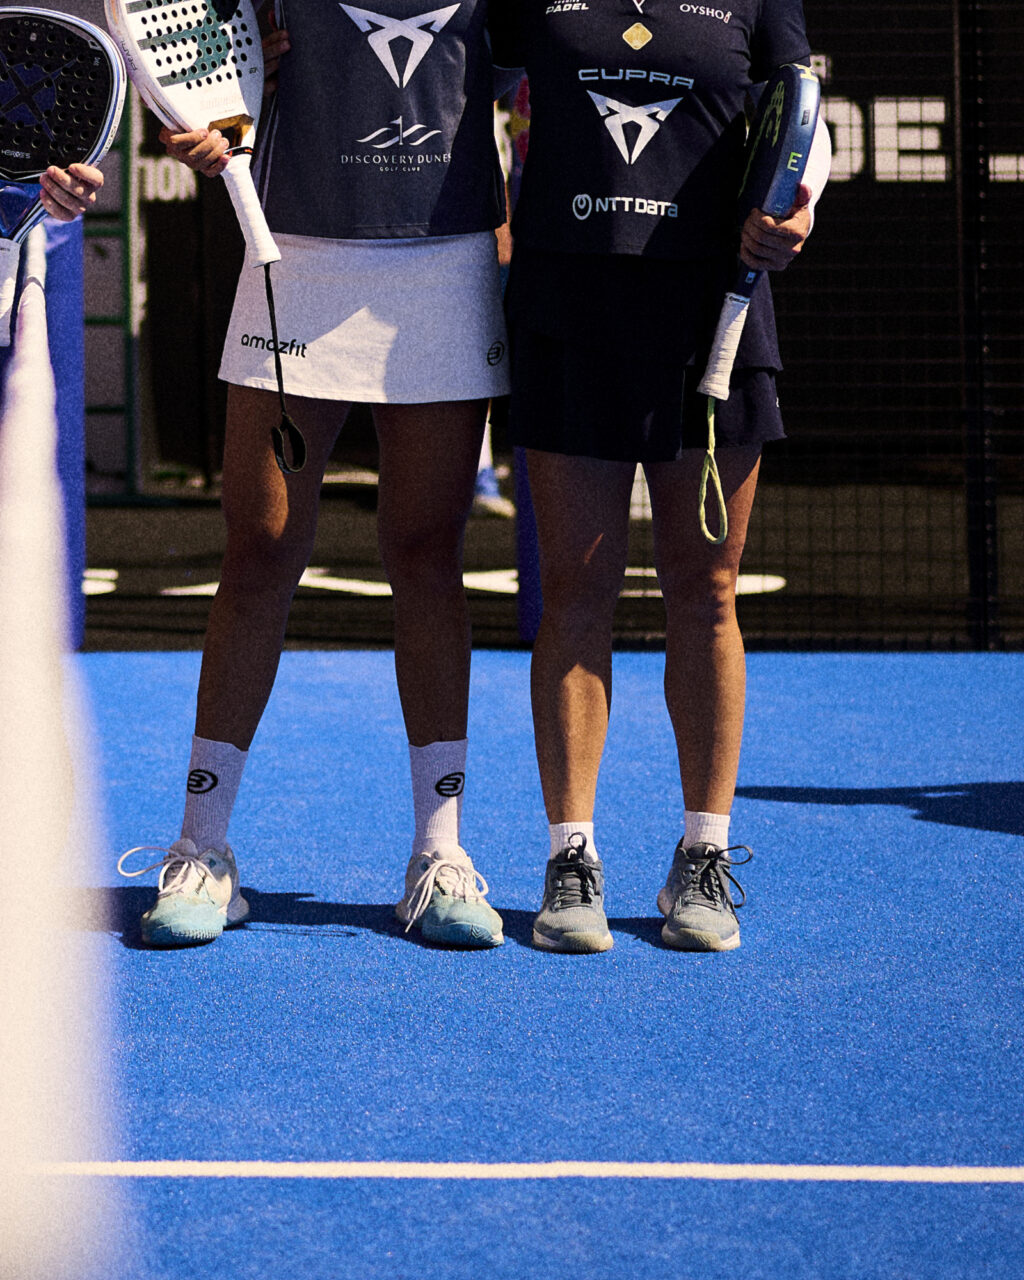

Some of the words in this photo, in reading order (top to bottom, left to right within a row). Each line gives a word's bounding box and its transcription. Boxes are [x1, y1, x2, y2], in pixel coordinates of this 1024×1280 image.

[546, 3, 589, 14] PADEL
[679, 3, 724, 19] OYSHO
[578, 68, 695, 90] CUPRA
[341, 153, 414, 165] DISCOVERY
